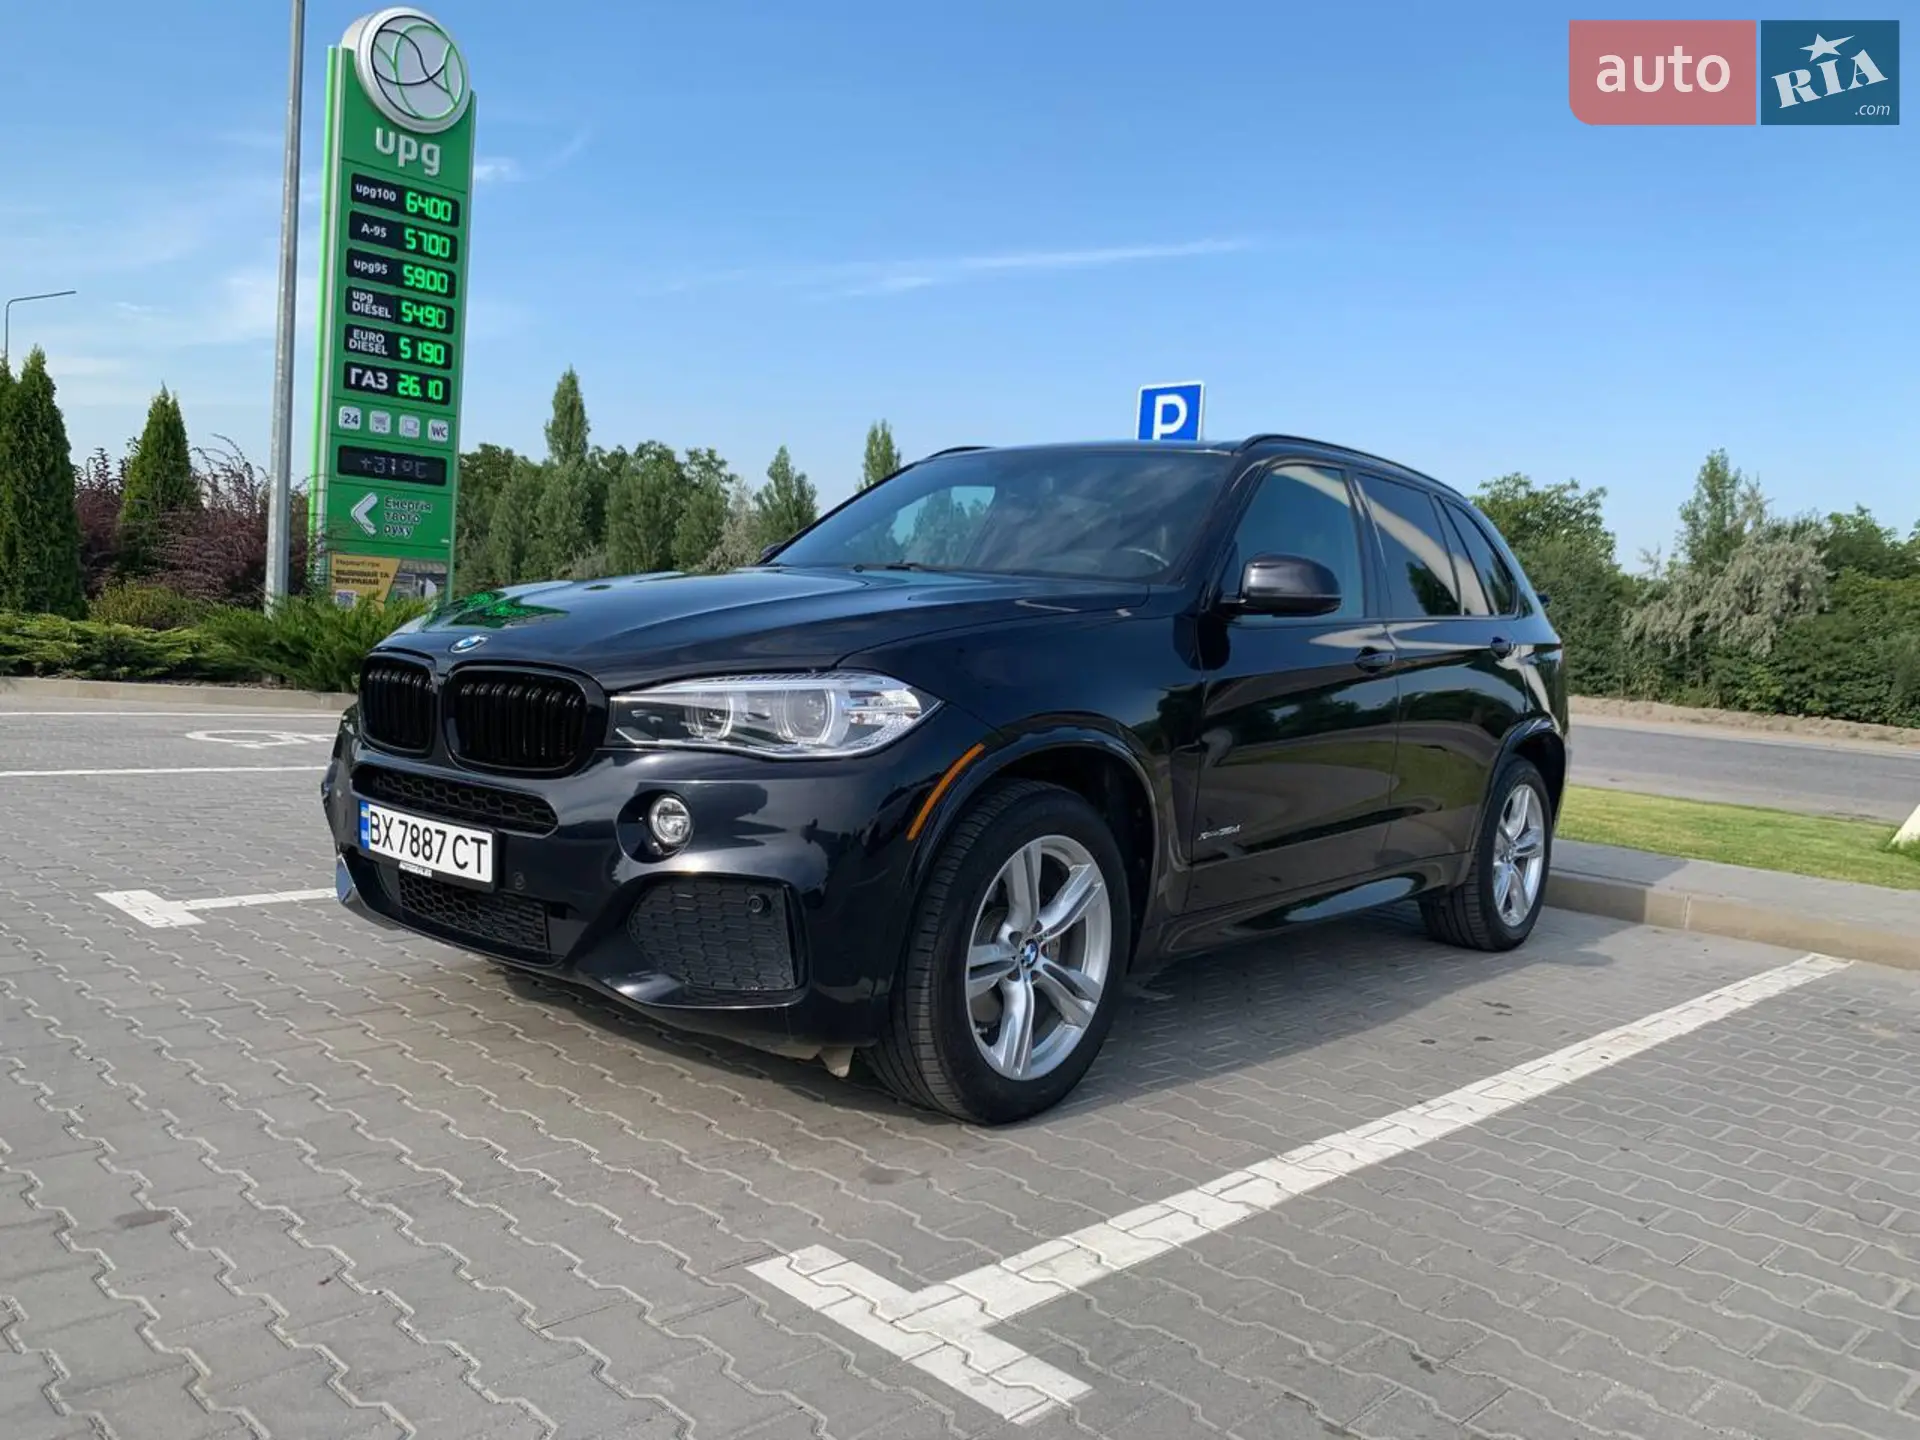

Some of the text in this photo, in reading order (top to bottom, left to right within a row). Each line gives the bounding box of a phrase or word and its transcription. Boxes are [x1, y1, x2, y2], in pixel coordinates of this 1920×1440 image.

[375, 127, 441, 176] upg
[355, 183, 397, 202] upg100
[361, 223, 387, 238] A-95
[353, 259, 388, 275] upg95
[352, 290, 374, 303] upg
[351, 302, 392, 319] DIESEL
[353, 329, 385, 343] EURO
[348, 338, 388, 356] DIESEL
[350, 367, 389, 390] ГАЗ
[344, 412, 359, 424] 24
[1153, 394, 1188, 440] P
[431, 426, 447, 438] WC
[384, 496, 432, 512] Енергія
[384, 511, 420, 526] твого
[384, 524, 413, 539] руху
[370, 811, 394, 852] BX
[398, 819, 448, 865] 7887
[452, 834, 489, 875] CT
